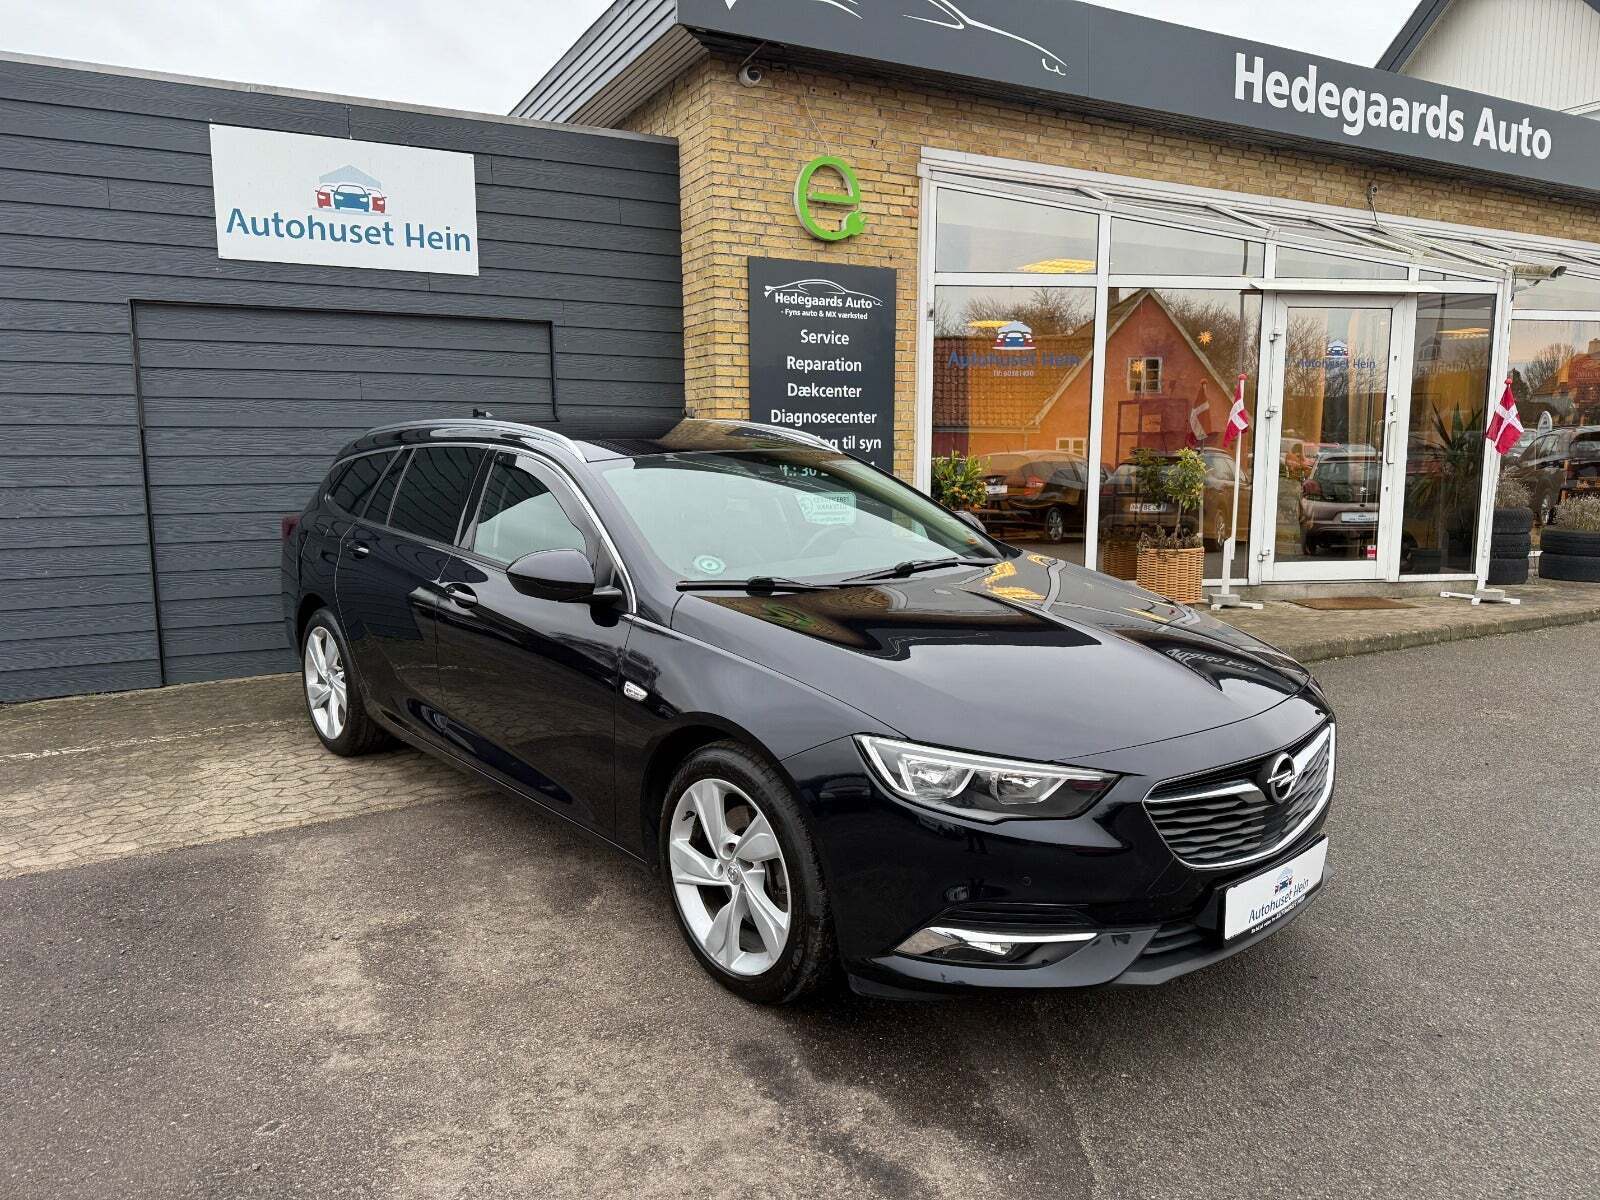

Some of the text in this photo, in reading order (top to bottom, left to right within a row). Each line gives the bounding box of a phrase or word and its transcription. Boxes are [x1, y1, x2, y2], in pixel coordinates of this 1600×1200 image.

[1234, 52, 1552, 160] Hedegaards Auto
[226, 207, 471, 252] Autohuset Hein
[774, 292, 874, 309] Hedegaards Auto
[784, 308, 801, 317] Fyns
[825, 310, 837, 318] MX
[837, 312, 868, 320] værksted
[800, 328, 850, 345] Service
[786, 355, 862, 374] Reparation
[946, 351, 1082, 369] Autohuset Hein
[1352, 358, 1376, 369] Hein
[787, 382, 862, 398] Dækcenter
[770, 409, 877, 427] Diagnosecenter
[842, 435, 856, 450] til
[859, 437, 882, 453] syn
[1248, 889, 1292, 924] Autohuset
[1293, 878, 1309, 898] Hein
